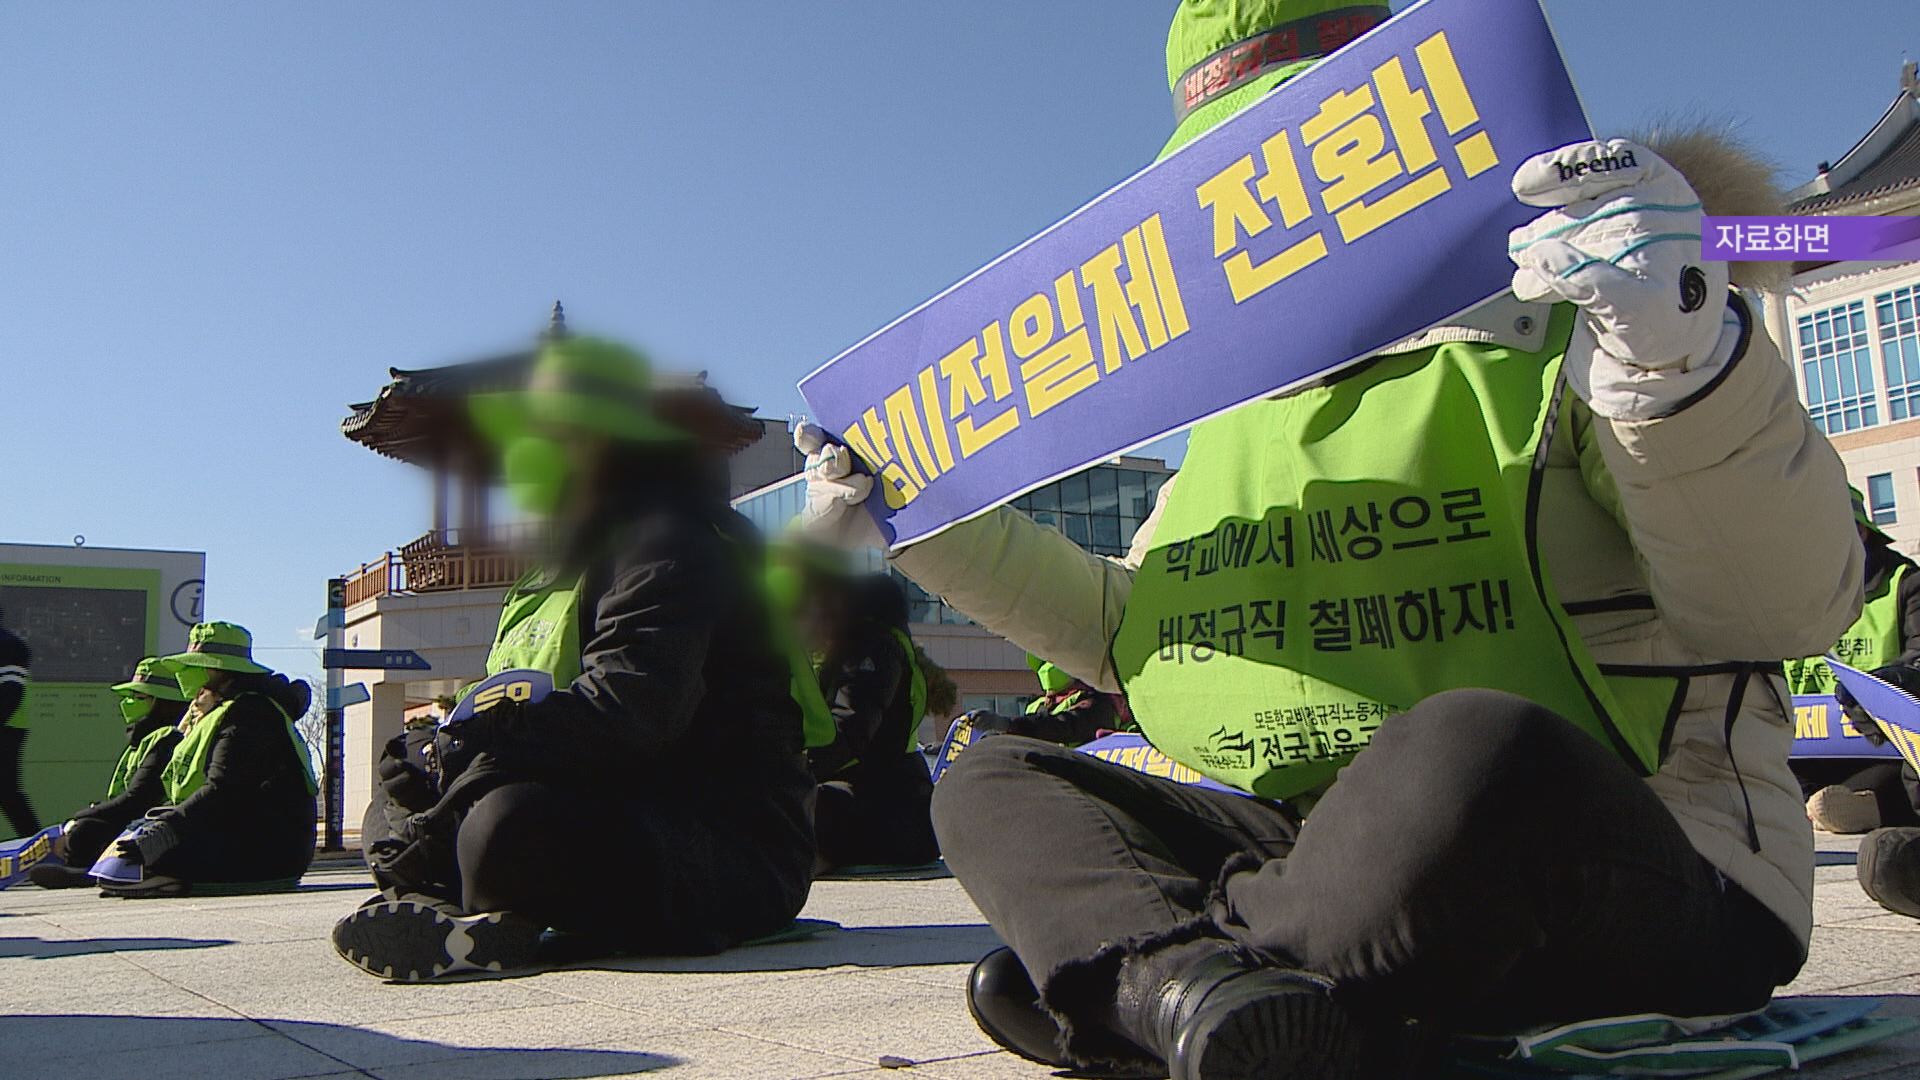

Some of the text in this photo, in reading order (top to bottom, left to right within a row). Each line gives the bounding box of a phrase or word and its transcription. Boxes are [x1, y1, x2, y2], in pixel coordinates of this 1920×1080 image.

[1185, 28, 1298, 109] 비정규직
[1553, 150, 1638, 182] beend
[843, 31, 1498, 508] 상시전일제 전환!
[1166, 487, 1492, 581] 학교에서 세상으로
[1, 574, 62, 584] INFORMATION
[1158, 579, 1515, 664] 비정규직 철폐하자!
